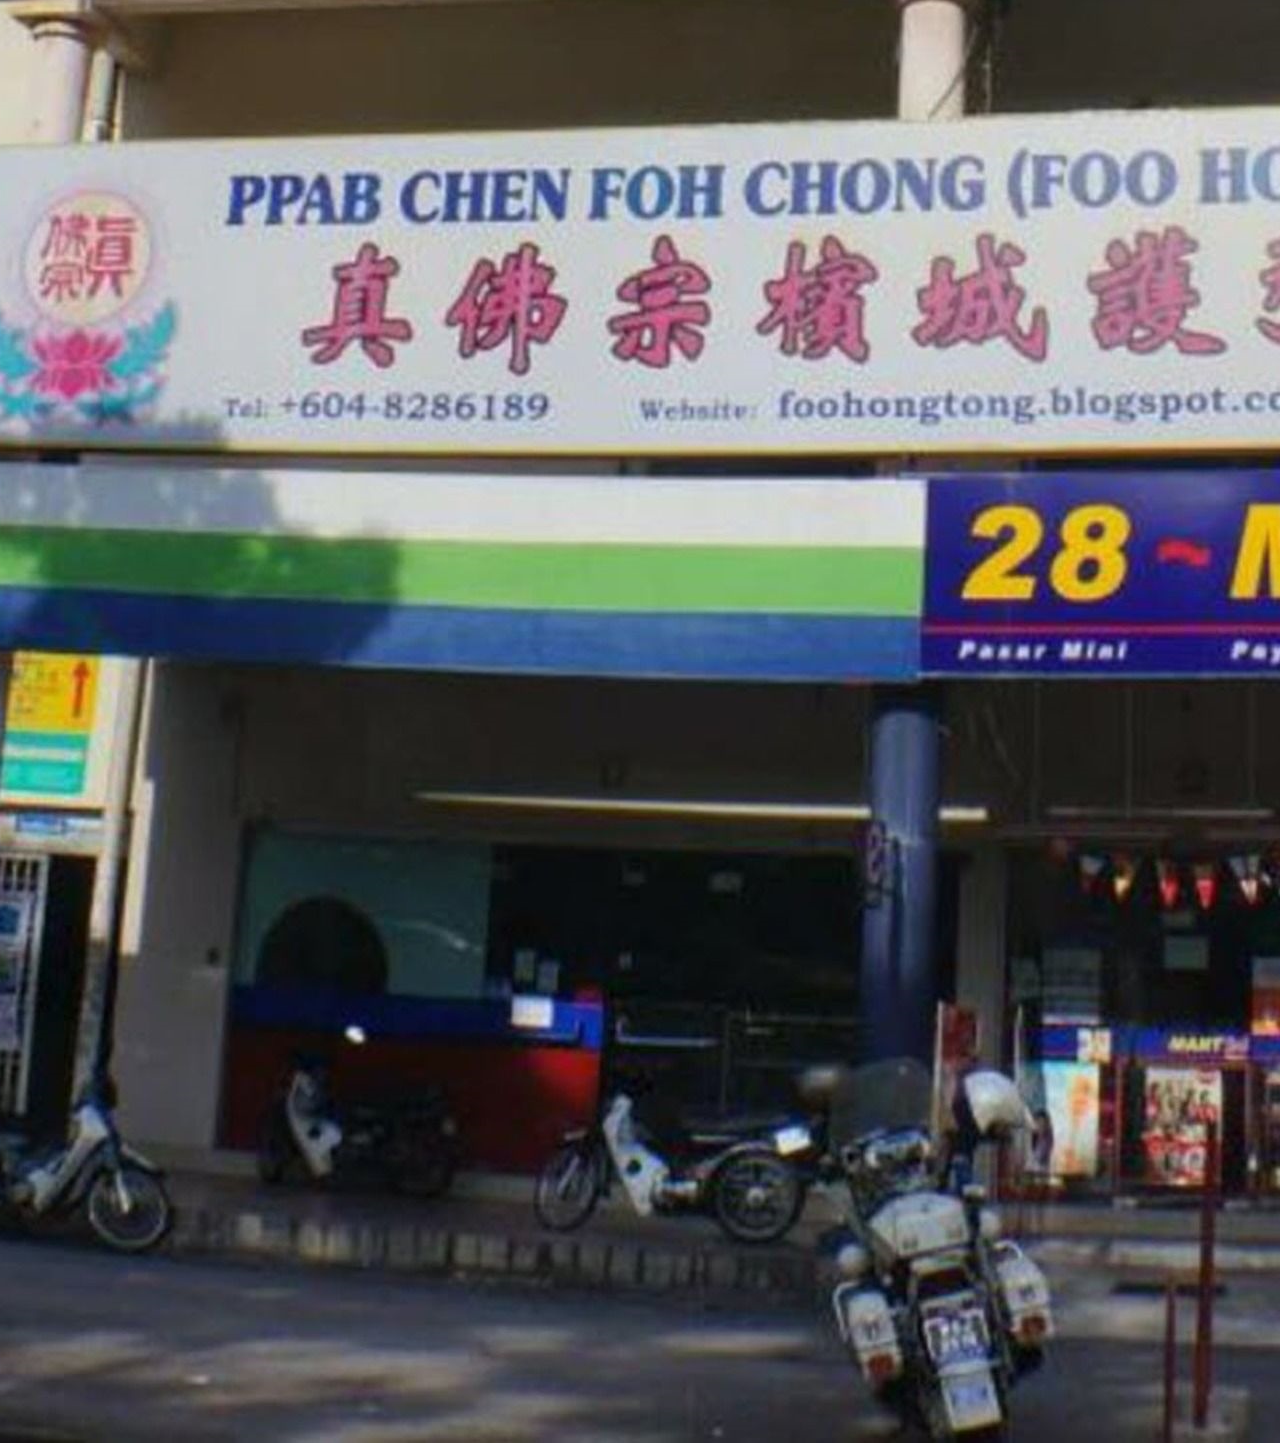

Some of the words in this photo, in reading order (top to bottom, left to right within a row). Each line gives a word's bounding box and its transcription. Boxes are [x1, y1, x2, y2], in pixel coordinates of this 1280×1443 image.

[225, 171, 382, 226] PPAB
[399, 168, 570, 223] CHEN
[588, 164, 726, 220] FOH
[744, 155, 987, 216] CHONG
[1007, 149, 1178, 219] (FOO
[278, 391, 550, 422] +604-8286189
[639, 398, 758, 424] Website:
[962, 504, 1131, 602] 28
[958, 639, 1047, 661] Pasar
[1062, 639, 1128, 661] Mini
